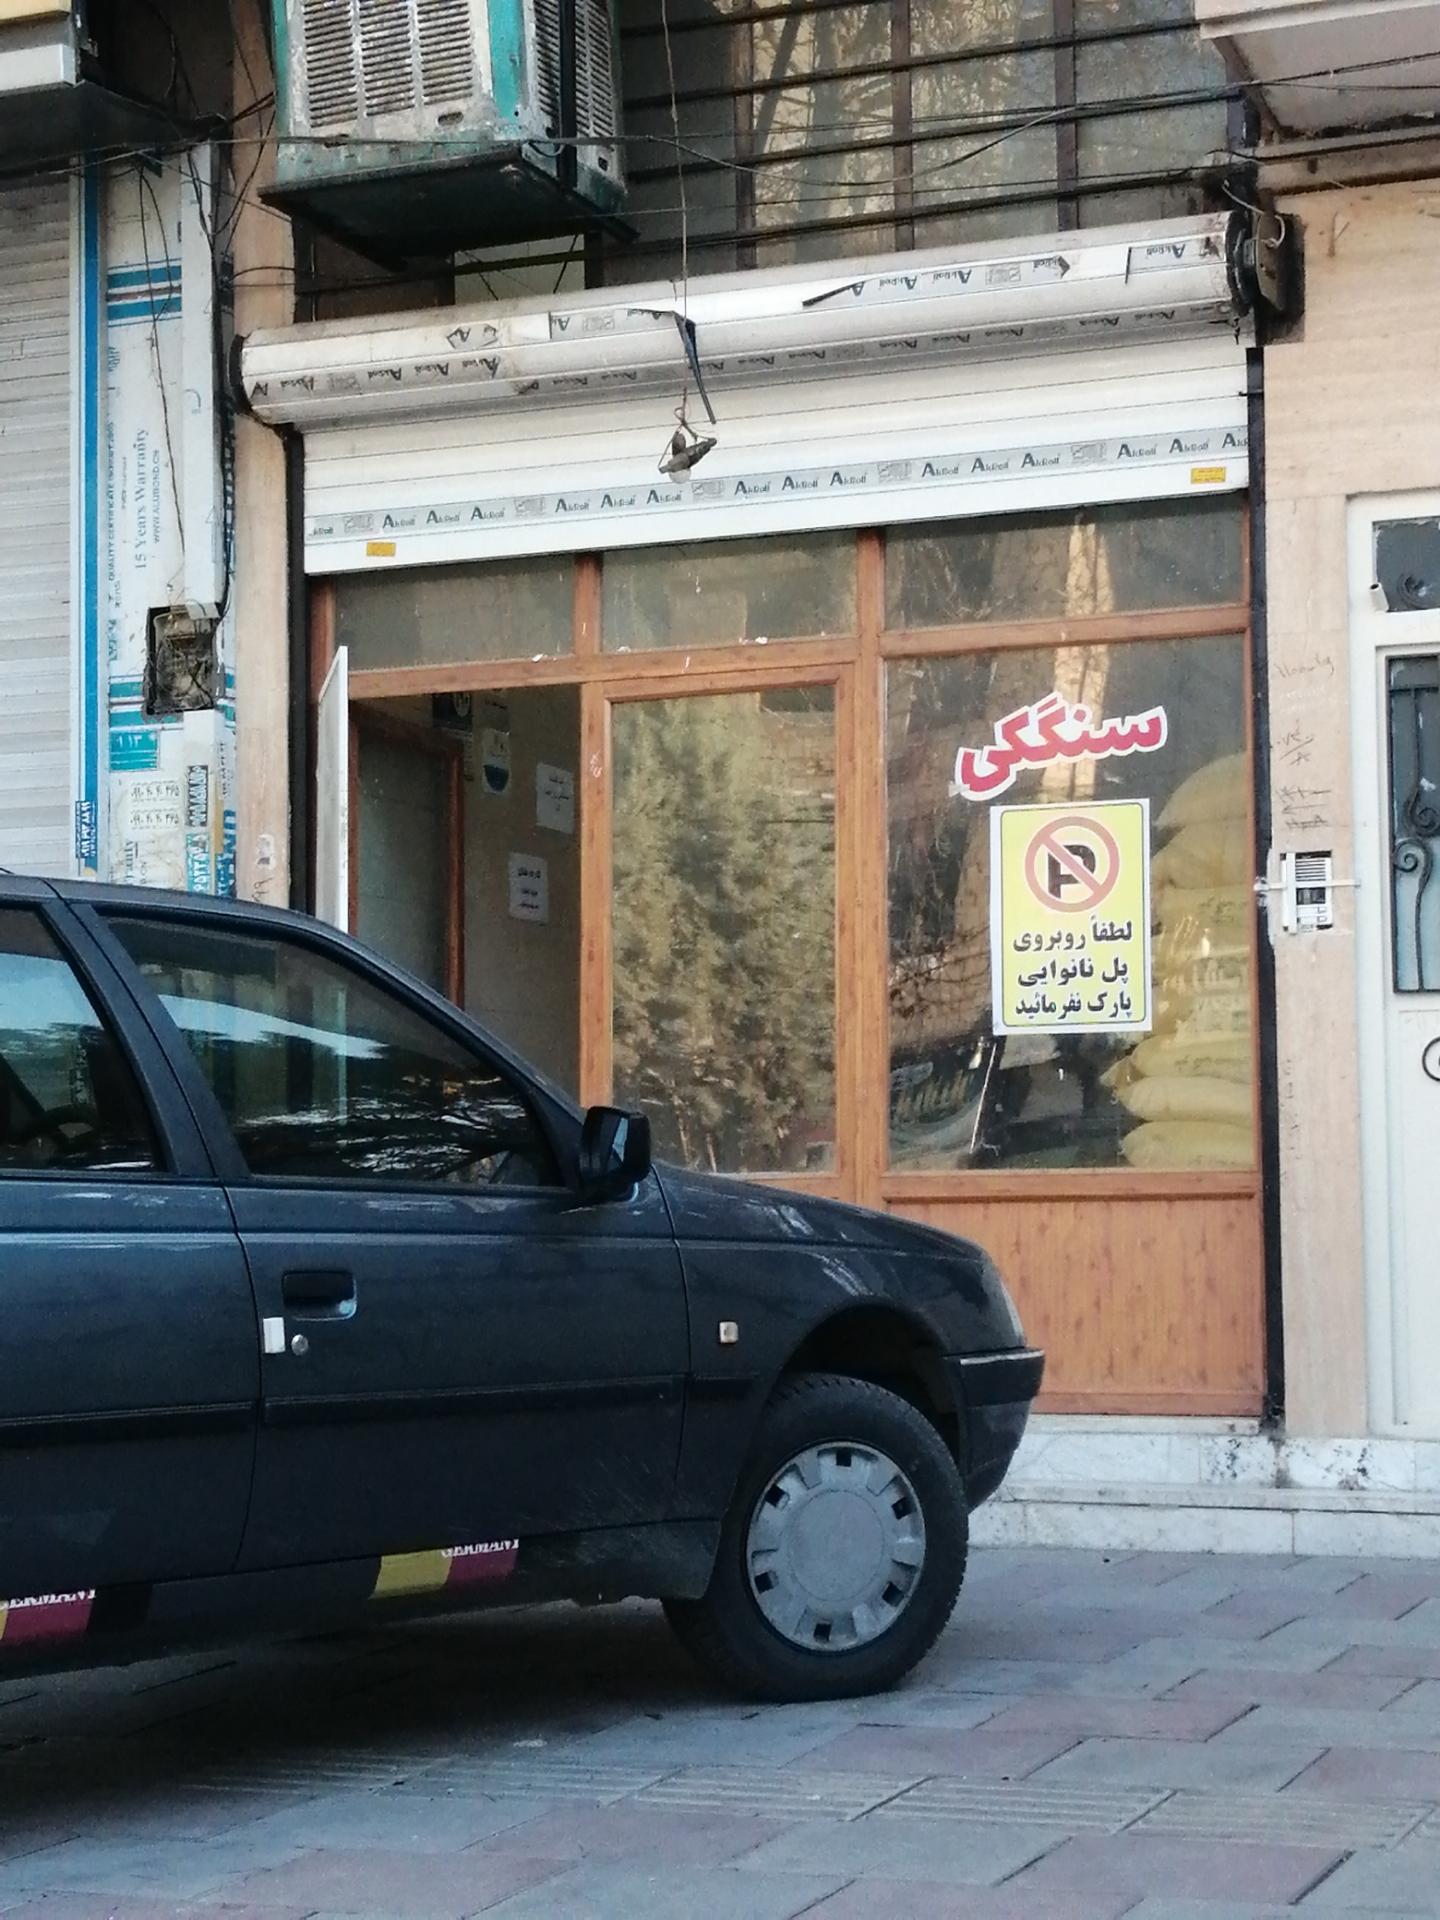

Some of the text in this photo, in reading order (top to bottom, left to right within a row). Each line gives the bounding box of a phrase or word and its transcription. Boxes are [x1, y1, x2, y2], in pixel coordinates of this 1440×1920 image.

[134, 430, 148, 502] Warranty
[135, 506, 146, 549] Years
[958, 694, 1164, 797] سنگکی
[1013, 930, 1086, 952] روبروی
[1018, 957, 1128, 987] پل نانوایی
[1087, 991, 1132, 1018] پارک
